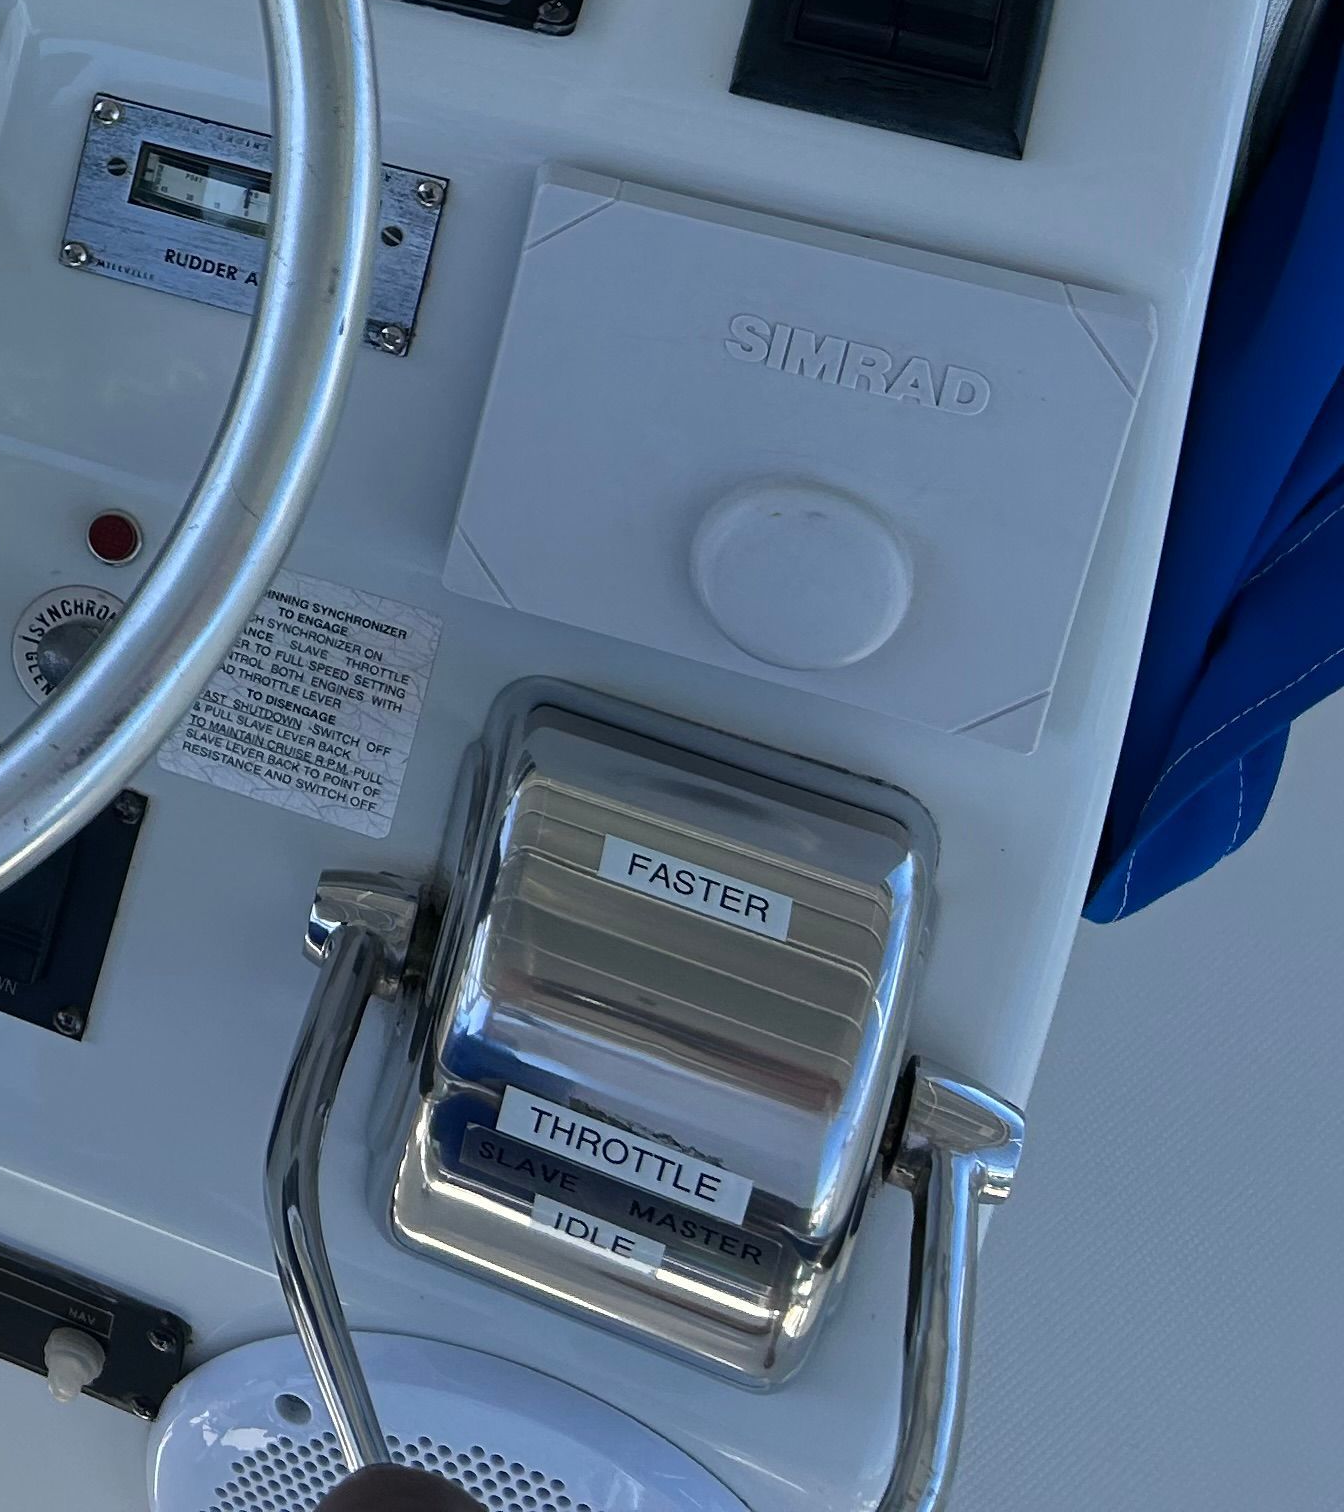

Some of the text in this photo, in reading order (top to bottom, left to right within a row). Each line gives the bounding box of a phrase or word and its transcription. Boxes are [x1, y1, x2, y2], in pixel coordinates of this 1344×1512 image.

[164, 248, 238, 281] RUDDER
[724, 313, 991, 415] SIMRAD
[29, 599, 116, 637] SYNCHRO
[267, 618, 361, 654] SYNCHRONIZER
[365, 649, 383, 661] ON
[279, 607, 348, 636] TO ENGAGE
[313, 604, 407, 639] SYNCHRONIZER
[228, 652, 403, 712] NTROL BOTH ENGINES WITH
[255, 643, 271, 656] TO
[275, 652, 303, 668] FULL
[309, 661, 349, 681] SPEED
[353, 675, 406, 699] SETTING
[290, 640, 411, 684] SLAVE THROTTLE
[239, 669, 341, 708] THROTTLE LEVER
[247, 689, 336, 725] TO DISENGAGE
[189, 714, 206, 727] TO
[209, 721, 264, 745] MAINTAIN
[267, 741, 312, 762] CRUISE
[193, 701, 352, 759] & PULL SLAVE LEVER BACK
[233, 699, 302, 729] SHUTDOWN
[367, 742, 392, 756] OFF
[182, 741, 376, 811] RESISTANCE AND SWITCH OFF
[186, 729, 380, 798] SLAVE LEVER BACK TO POINT OF
[628, 853, 769, 922] FASTER
[531, 1106, 721, 1202] THROTTLE
[479, 1142, 762, 1264] SLAVE MASTER
[554, 1213, 635, 1258] IDLE
[68, 1307, 95, 1325] NAV
